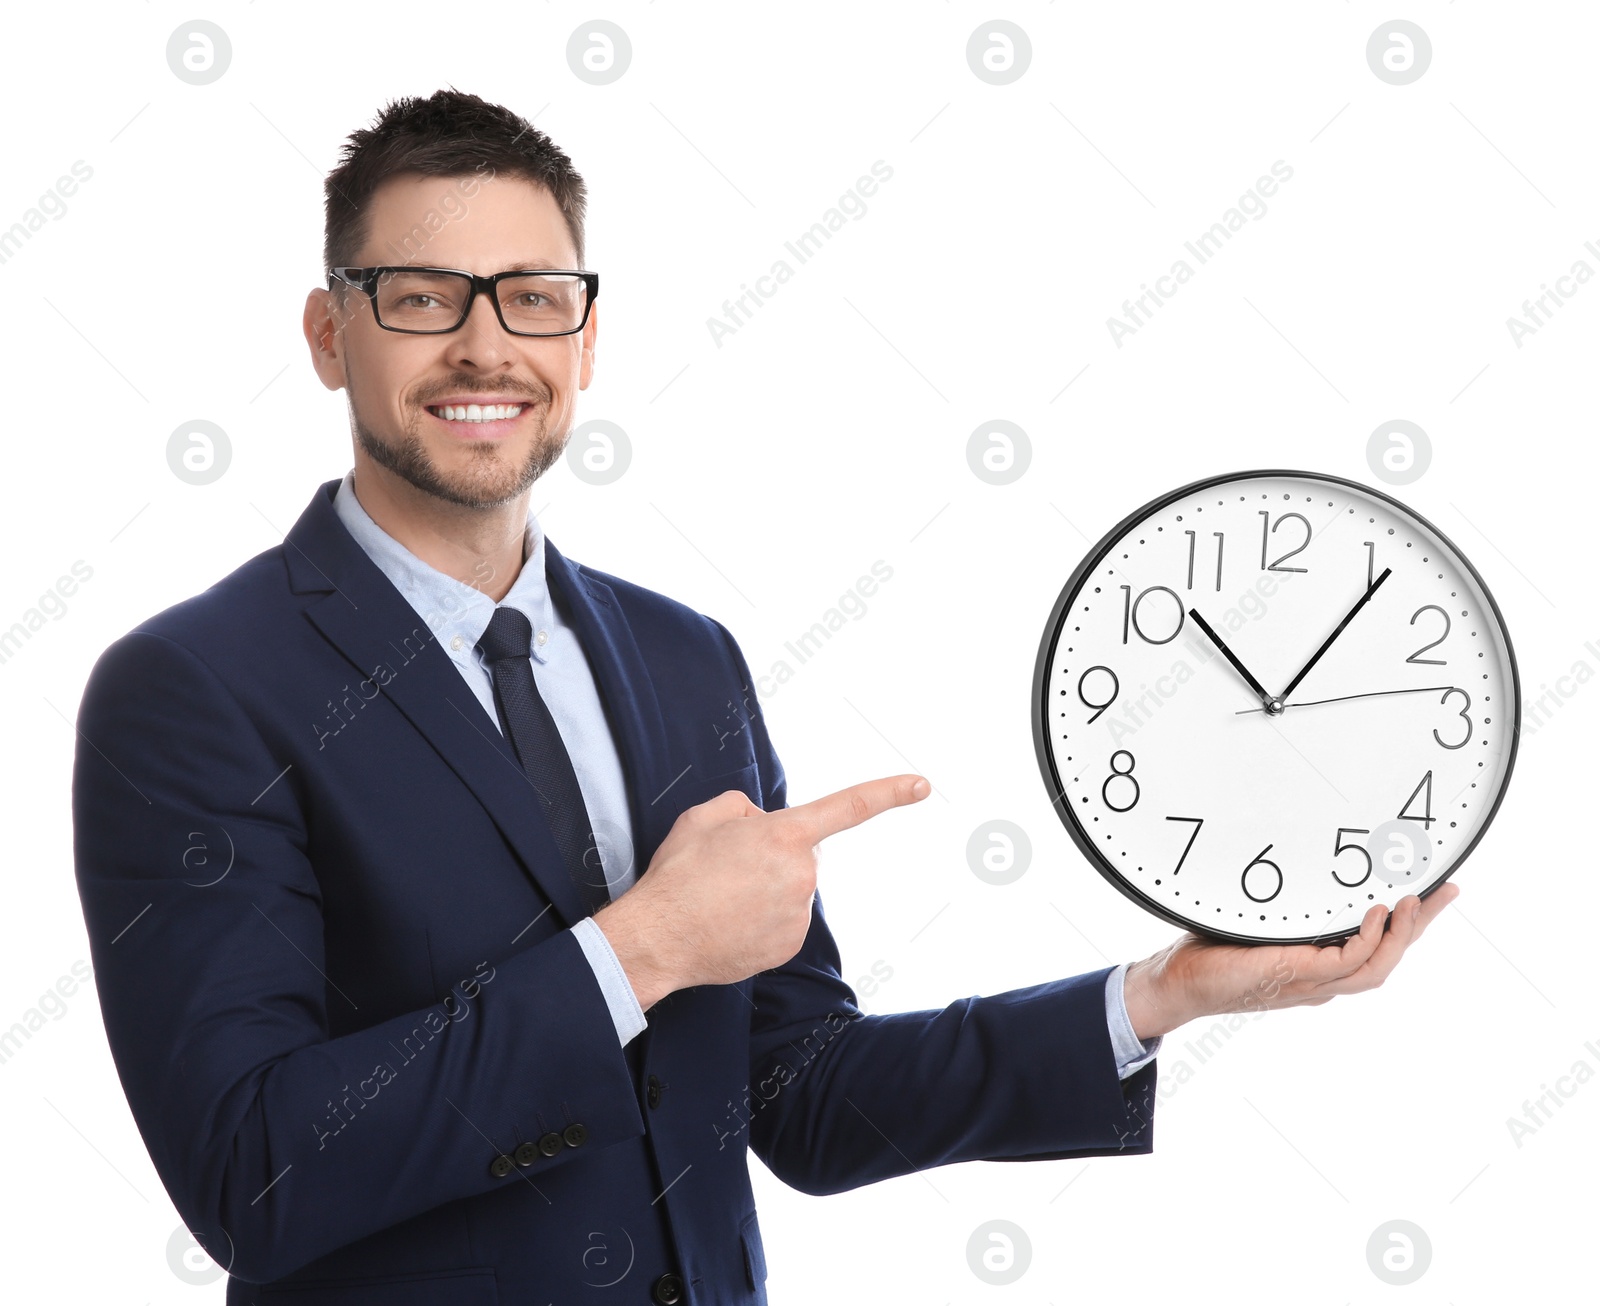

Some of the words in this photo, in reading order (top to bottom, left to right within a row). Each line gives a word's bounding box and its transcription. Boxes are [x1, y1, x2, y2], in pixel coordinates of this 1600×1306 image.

[1185, 530, 1223, 591] 11
[1258, 511, 1311, 573] 12
[1363, 541, 1375, 601] 1
[1120, 585, 1185, 645] 10
[1405, 605, 1450, 665] 2
[1078, 666, 1119, 724] 9
[1433, 687, 1473, 750] 3
[1102, 750, 1140, 812] 8
[1397, 770, 1436, 830] 4
[1166, 816, 1203, 875] 7
[1241, 844, 1283, 903] 6
[1332, 828, 1372, 887] 5
